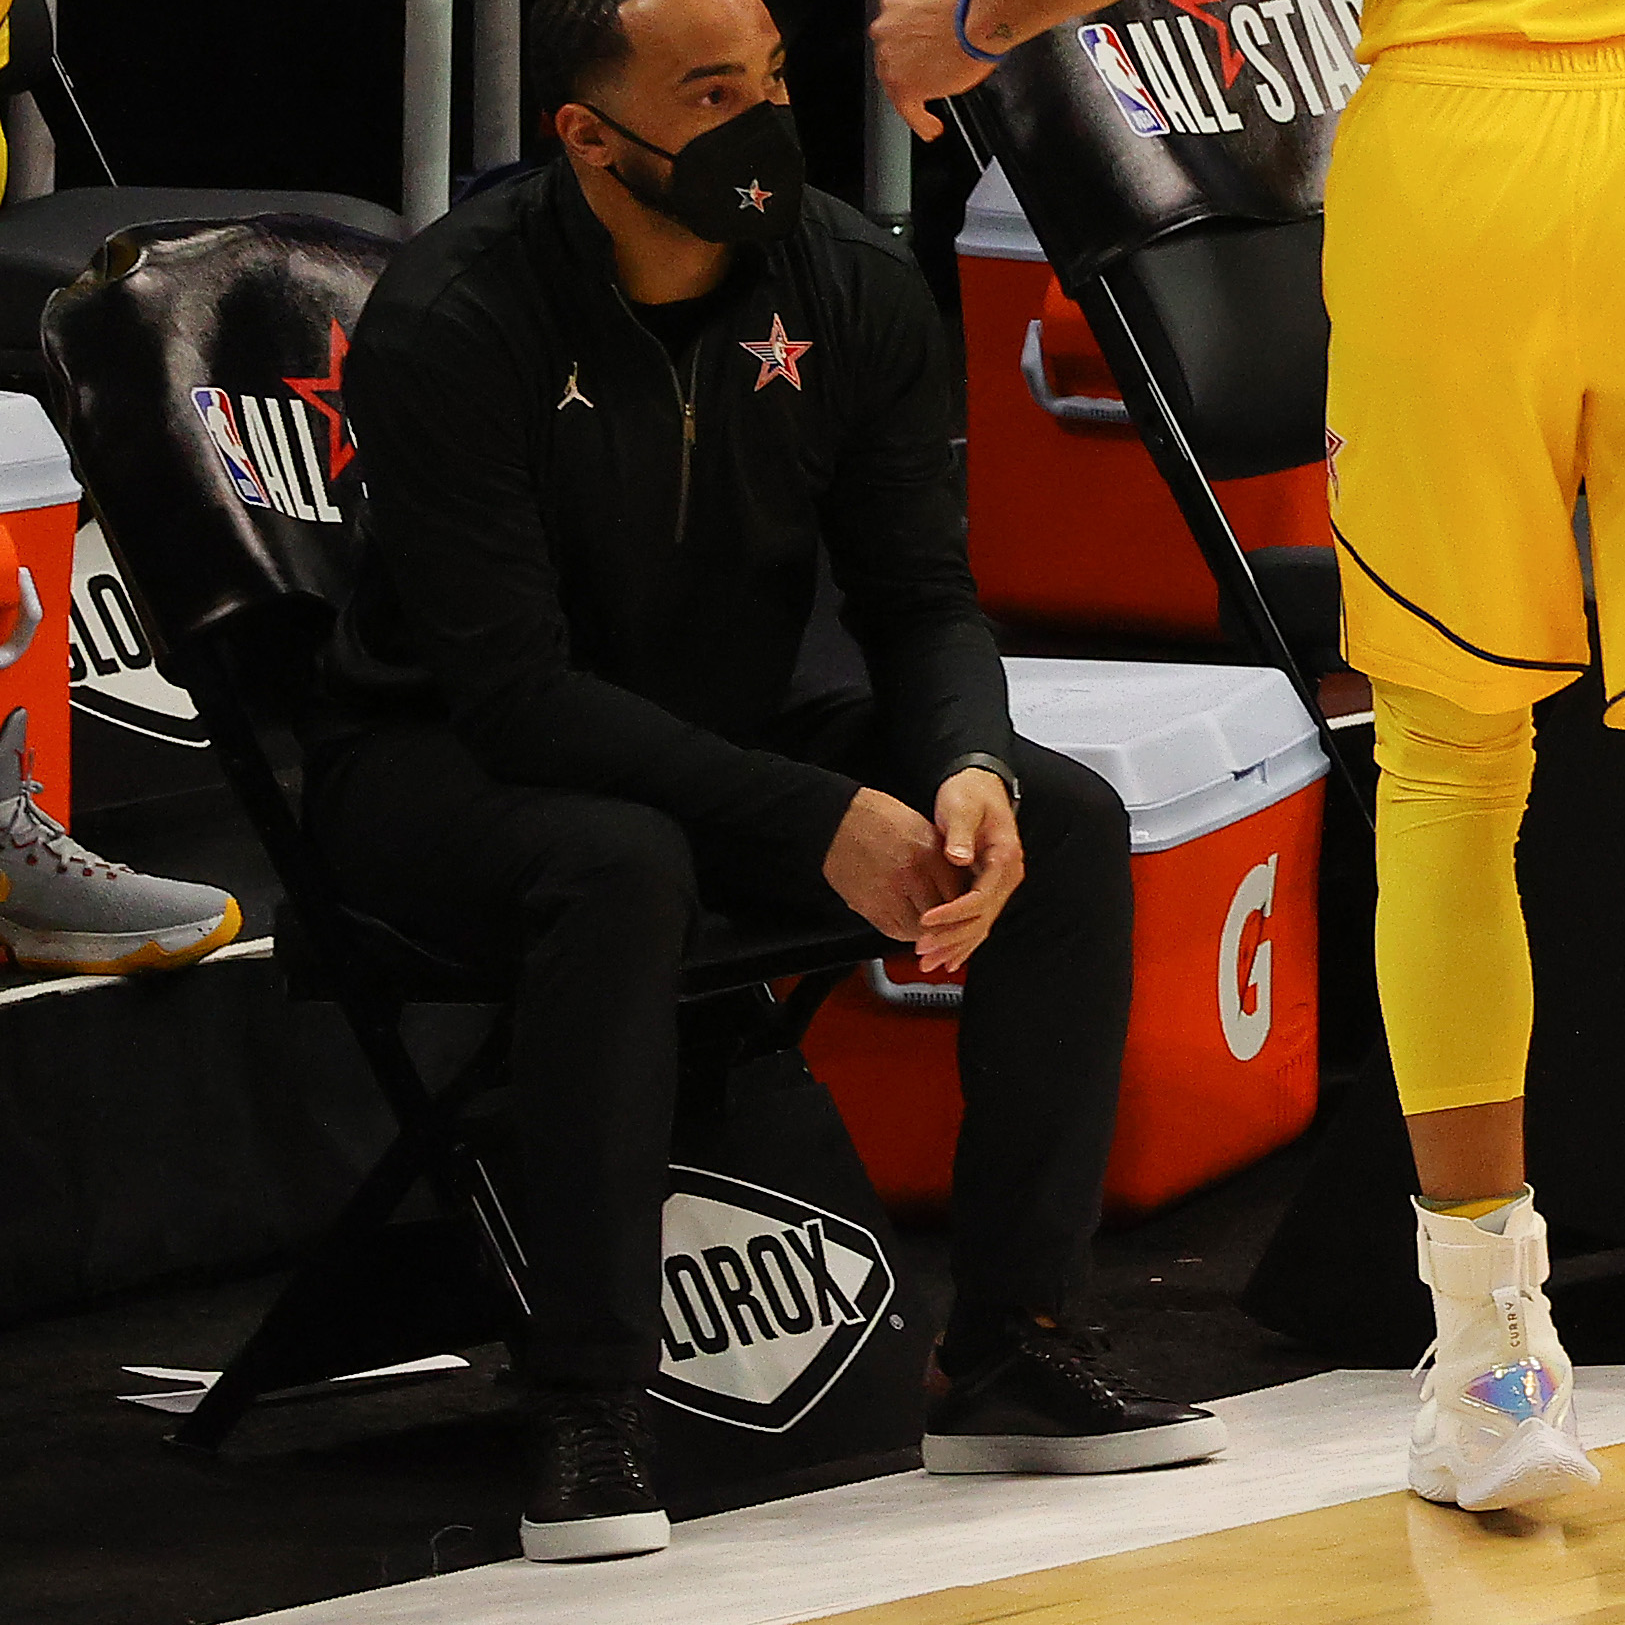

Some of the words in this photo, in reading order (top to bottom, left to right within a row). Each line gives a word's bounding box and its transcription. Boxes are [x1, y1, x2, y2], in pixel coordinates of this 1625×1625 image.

[1126, 15, 1245, 135] ALL
[240, 394, 343, 523] ALL
[1218, 852, 1278, 1061] G
[661, 1221, 862, 1362] LOROX
